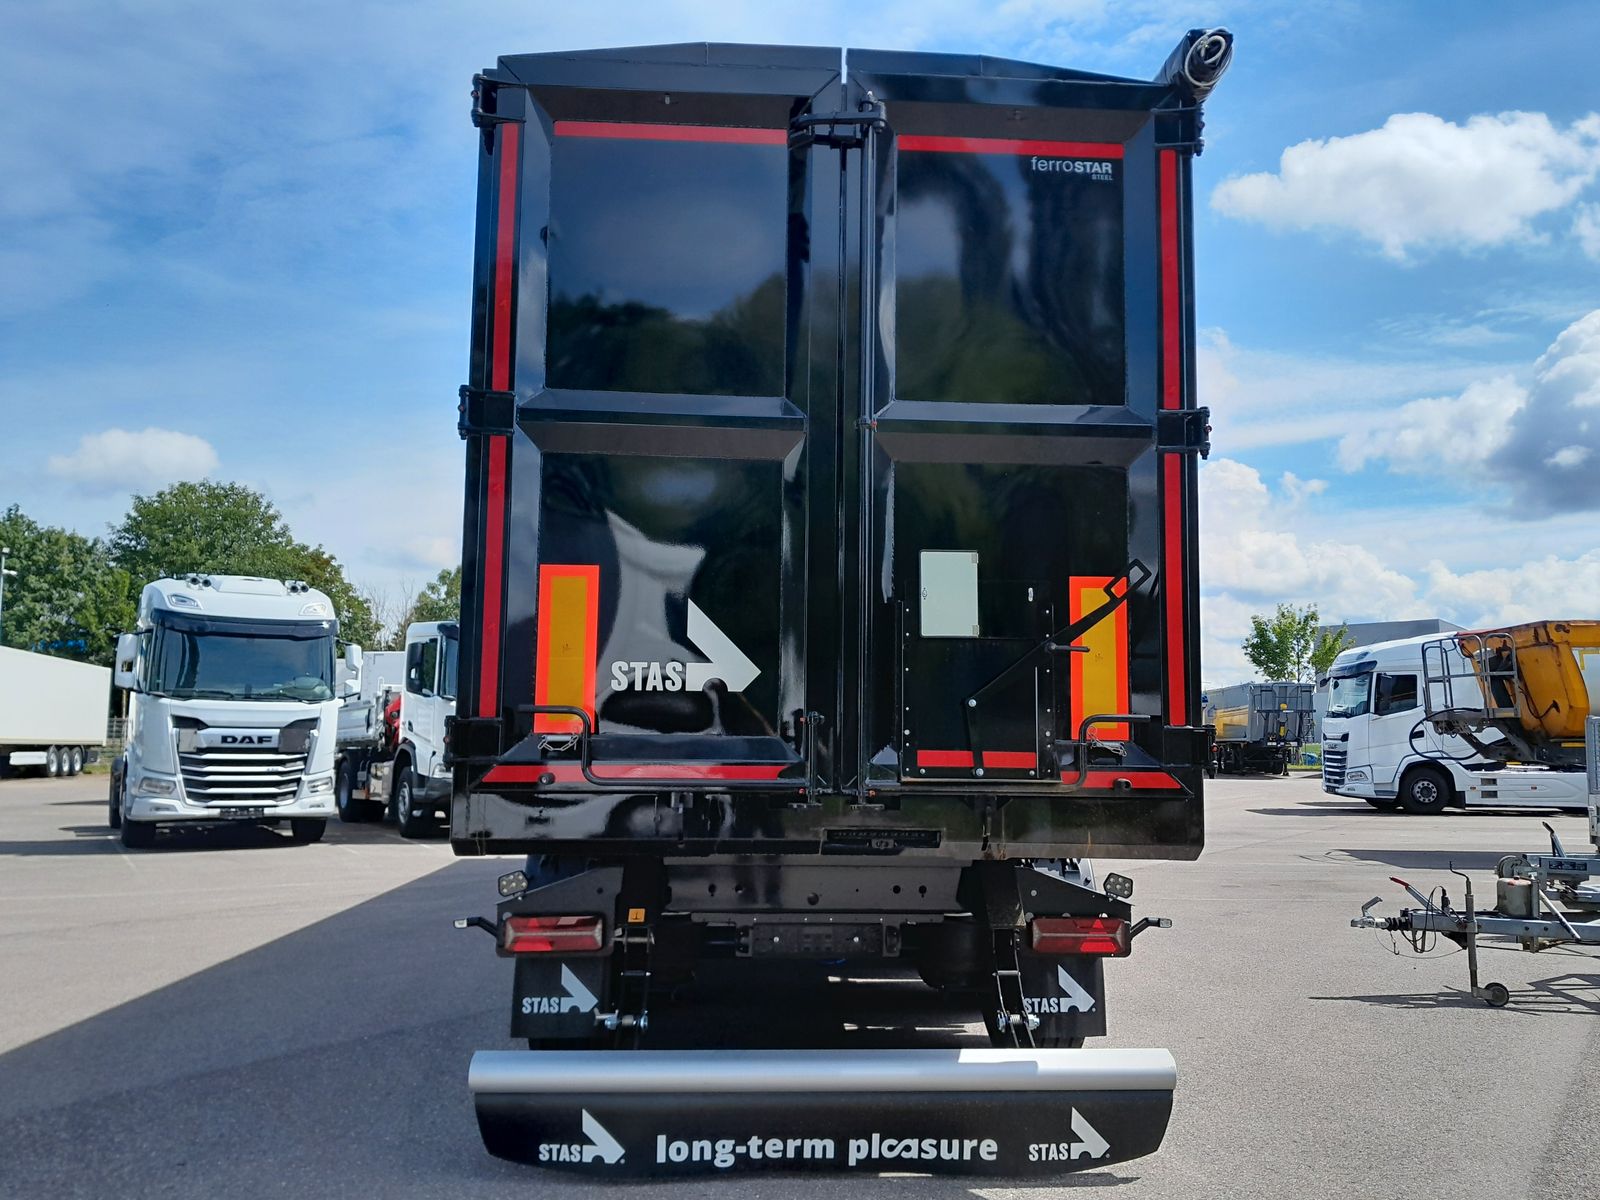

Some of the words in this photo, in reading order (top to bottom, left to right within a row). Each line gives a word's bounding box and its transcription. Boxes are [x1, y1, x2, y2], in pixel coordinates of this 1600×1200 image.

[1031, 156, 1112, 174] ferroSTAR
[1091, 173, 1113, 181] STEEL
[610, 660, 683, 692] STAS
[221, 735, 273, 744] DAF
[522, 996, 560, 1014] STAS
[1023, 997, 1059, 1014] STAS
[538, 1143, 581, 1163] STAS
[656, 1134, 835, 1168] long-term
[848, 1133, 998, 1166] pleasure
[1028, 1142, 1069, 1162] STAS
